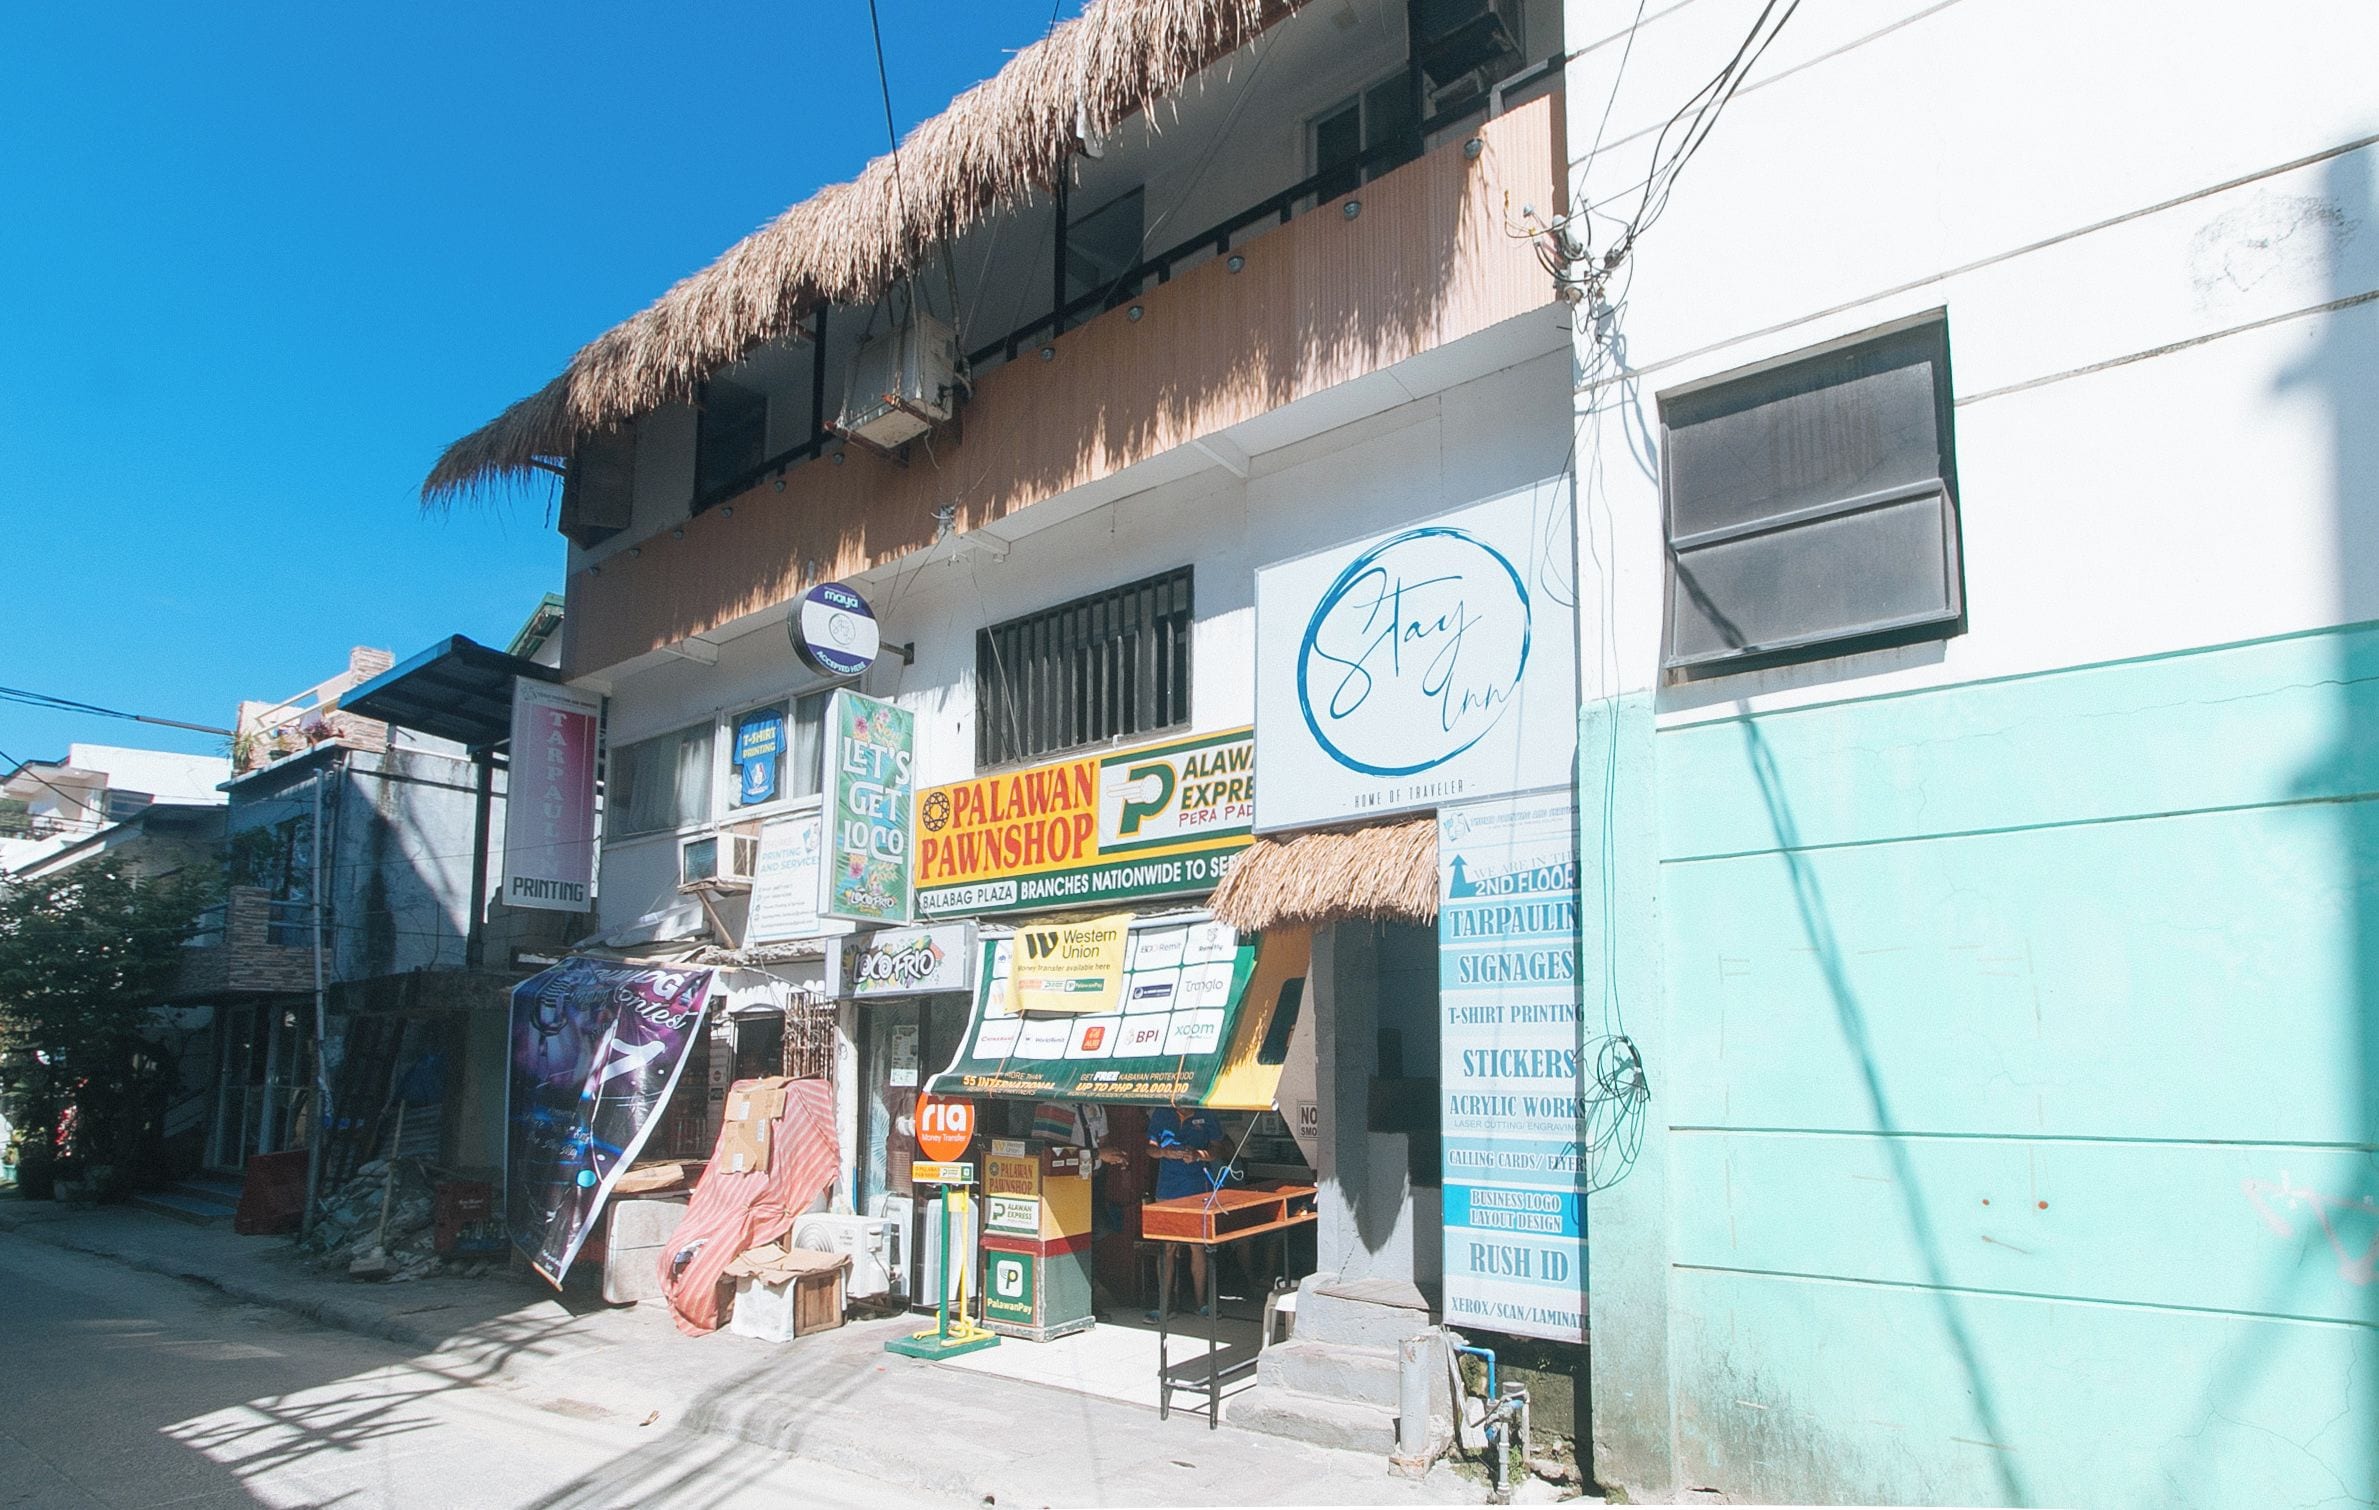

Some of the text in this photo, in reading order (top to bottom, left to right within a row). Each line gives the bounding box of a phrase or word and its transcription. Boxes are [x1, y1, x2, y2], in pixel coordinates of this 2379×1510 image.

[824, 590, 858, 608] maya
[1314, 567, 1482, 719] Stay
[816, 651, 867, 673] ACCEPTED HERE
[1442, 672, 1508, 732] Inn
[743, 727, 776, 746] T-SHIRT
[843, 735, 910, 785] LET'S
[849, 780, 902, 822] GET
[952, 761, 1096, 829] PALAWAN
[1355, 779, 1464, 809] HOME OF TRAVELER
[1179, 808, 1217, 828] PERA
[843, 819, 904, 865] LOCO
[920, 812, 1094, 881] PAWNSHOP
[512, 876, 585, 903] PRINTING
[1021, 872, 1090, 901] BRANCHES
[1092, 863, 1183, 892] NATIONWIDE
[1185, 859, 1206, 881] TO
[1475, 863, 1577, 897] 2ND FLOOR
[922, 883, 1014, 911] BALABAG PLAZA
[1450, 902, 1581, 937] TARPAULIN
[1063, 929, 1117, 944] Western
[1062, 945, 1100, 959] Union
[1066, 963, 1093, 971] available
[1460, 950, 1575, 984] SIGNAGES
[614, 981, 699, 1030] Contest
[1448, 1003, 1584, 1025] T-SHIRT PRINTING
[1136, 1030, 1159, 1043] BPI
[1175, 1023, 1215, 1036] xoom
[1463, 1049, 1577, 1078] STICKERS
[963, 1075, 976, 1086] 55
[1075, 1083, 1093, 1091] UP
[1094, 1083, 1108, 1091] TO
[1108, 1083, 1133, 1092] PHP
[922, 1103, 966, 1132] ria
[1301, 1106, 1318, 1124] NO
[1450, 1095, 1585, 1119] ACRYLIC WORKS
[1301, 1127, 1318, 1136] SMO
[1454, 1119, 1482, 1128] LASER
[922, 1133, 966, 1143] Money Transfer
[1000, 1162, 1033, 1179] PALAWAN
[1449, 1150, 1494, 1166] CALLING
[1499, 1153, 1543, 1169] CARDS/
[989, 1178, 1033, 1195] PAWNSHOP
[1471, 1190, 1560, 1211] BUSINESS LOGO
[1008, 1211, 1032, 1220] EXPRESS
[1471, 1208, 1562, 1233] LAYOUT DESIGN
[1469, 1242, 1568, 1282] RUSH ID
[987, 1297, 1032, 1315] PalawanPay
